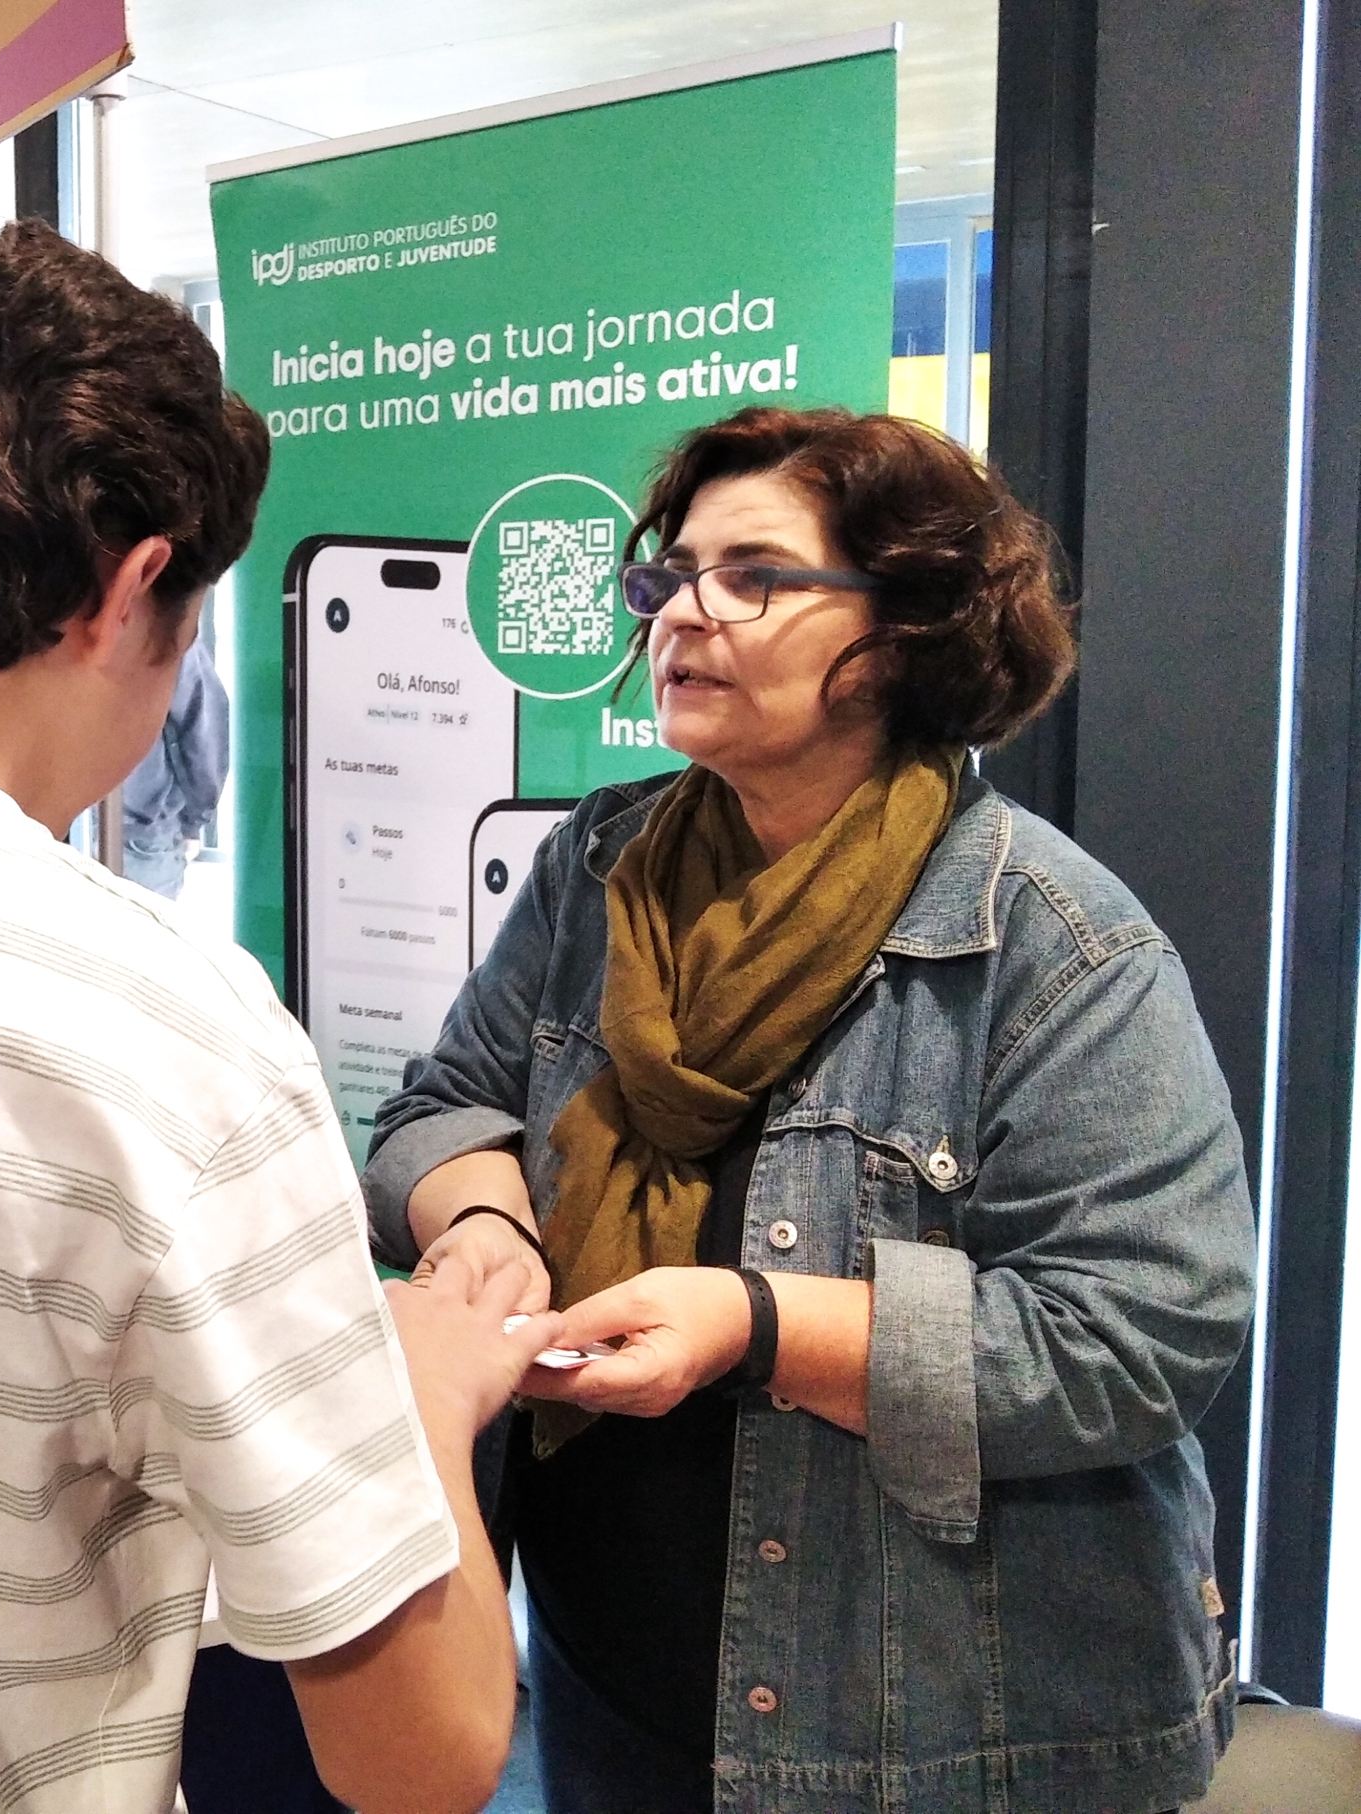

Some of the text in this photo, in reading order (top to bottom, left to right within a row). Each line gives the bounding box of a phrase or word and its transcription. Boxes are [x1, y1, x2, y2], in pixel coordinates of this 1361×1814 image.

[298, 211, 498, 260] INSTITUTO PORTUGUÊS DO
[297, 236, 497, 281] DESPORTO E JUVENTUDE
[273, 289, 775, 387] Inicia hoje a tua jornada
[268, 344, 799, 438] para uma vida mais ativa!
[333, 610, 342, 622] A
[377, 672, 460, 696] Olá, Afonso!
[325, 757, 399, 776] As tuas metas
[372, 825, 403, 839] Passos
[491, 870, 501, 883] A
[339, 1003, 403, 1021] Meta semanal
